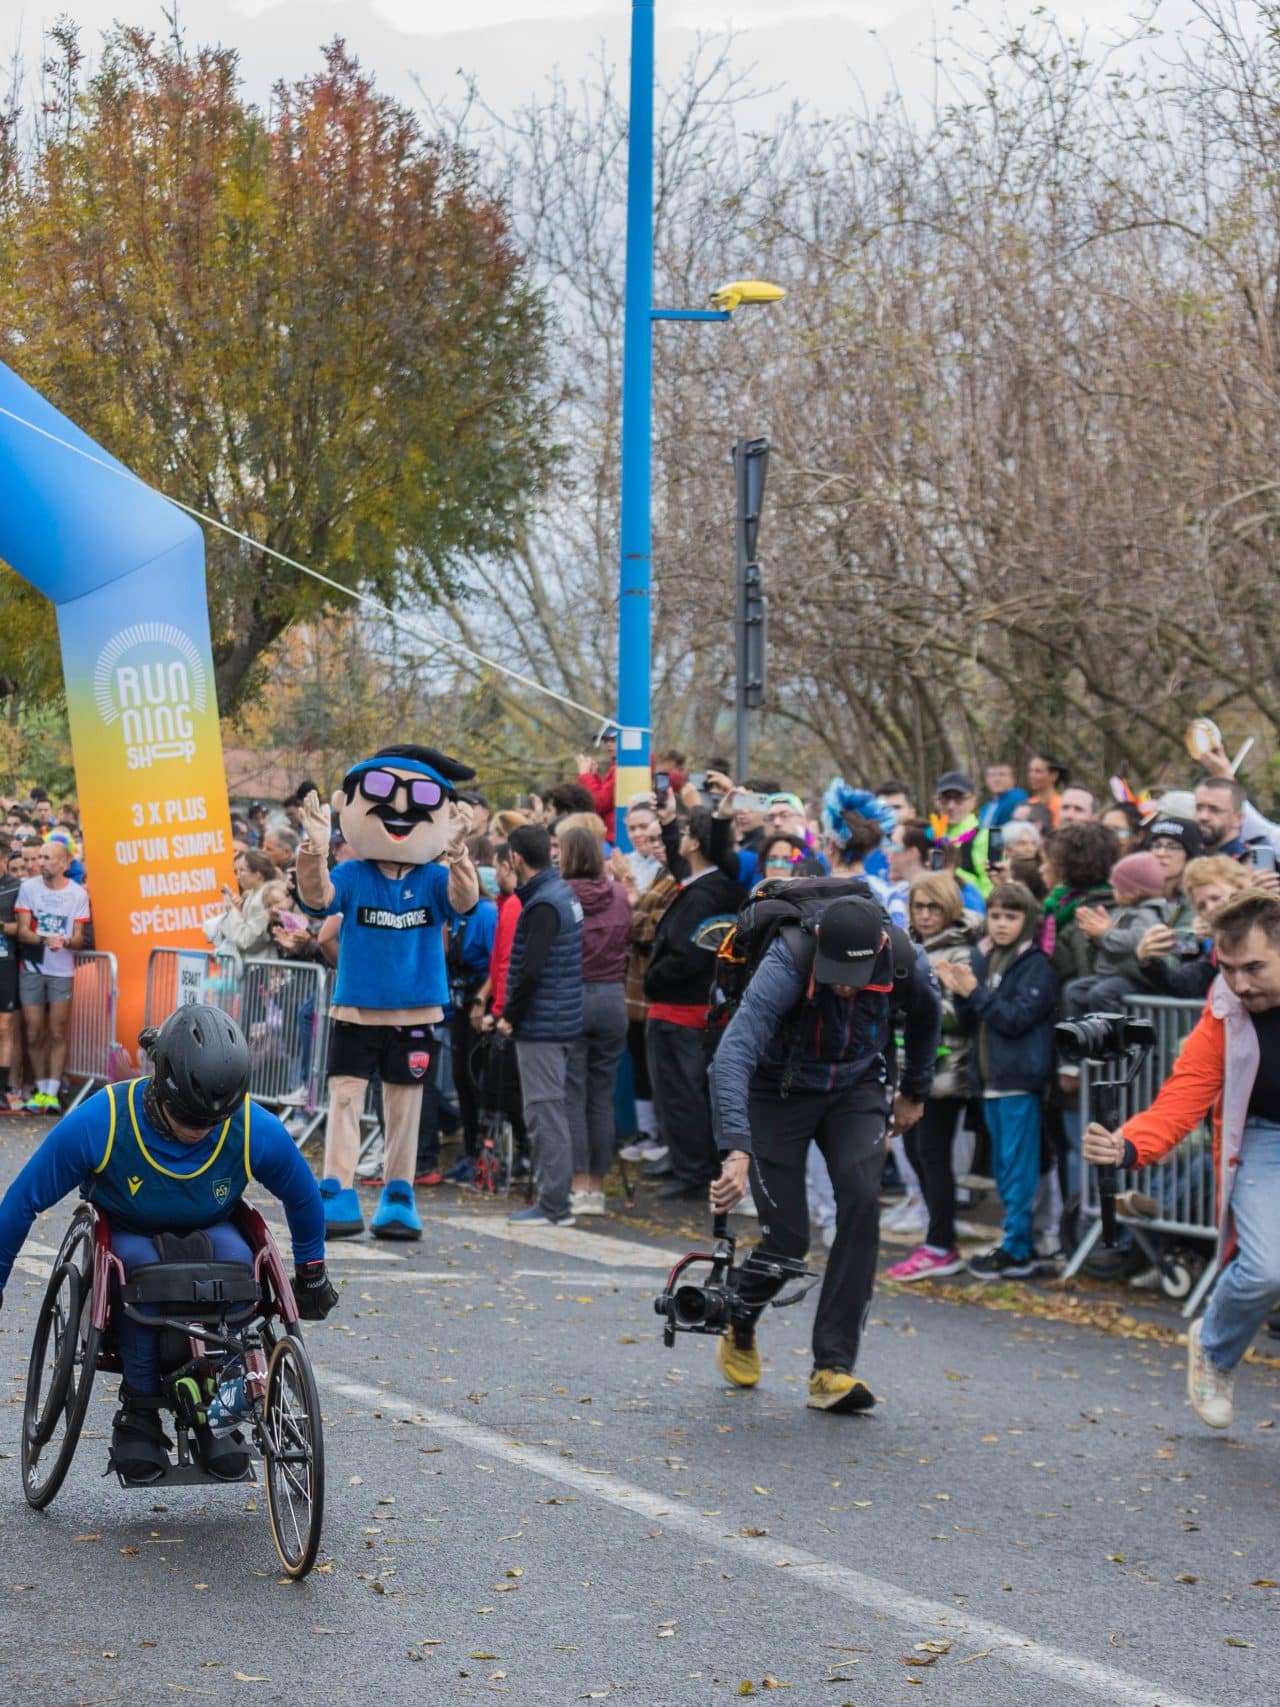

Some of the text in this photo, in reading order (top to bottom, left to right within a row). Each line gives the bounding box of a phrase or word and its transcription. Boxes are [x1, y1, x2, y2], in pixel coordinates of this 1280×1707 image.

[116, 661, 190, 707] RUN
[121, 704, 194, 744] NING
[127, 740, 197, 769] SHOP
[131, 796, 208, 827] 3 X PLUS
[115, 829, 226, 865] QU'UN SIMPLE
[139, 867, 217, 898] MAGASIN
[364, 908, 376, 924] LA
